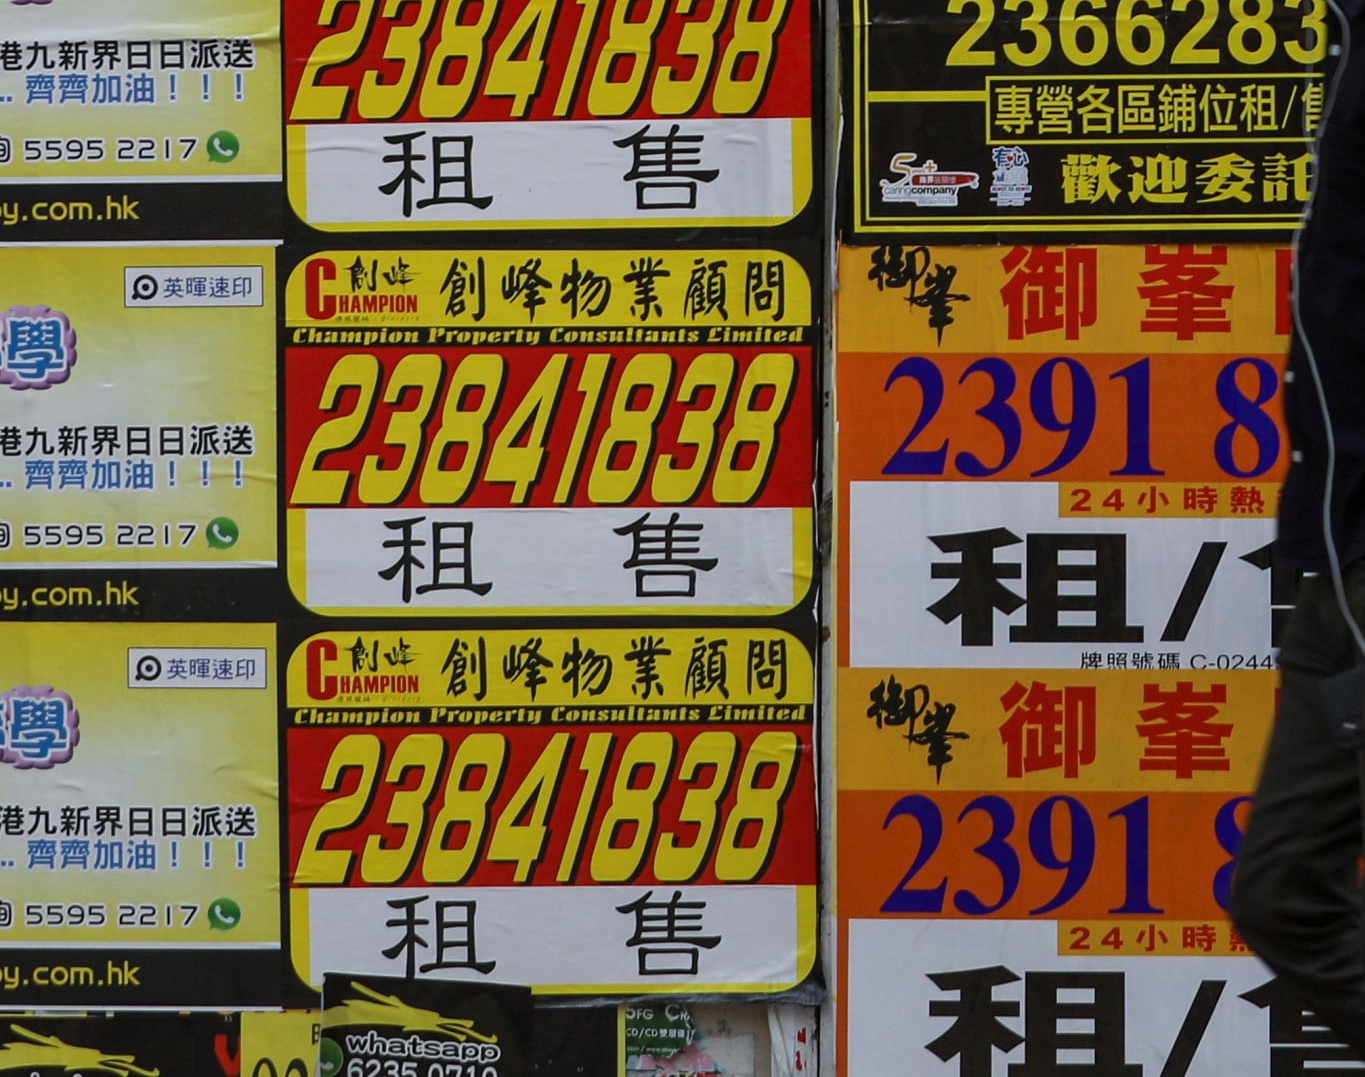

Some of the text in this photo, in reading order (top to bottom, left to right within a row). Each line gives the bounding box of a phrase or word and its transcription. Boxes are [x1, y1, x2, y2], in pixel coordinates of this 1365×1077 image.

[23, 136, 196, 160] 5595 2217
[163, 275, 253, 299] 英暉速印
[440, 258, 786, 321] 創峰物業顧問
[291, 352, 796, 505] 23841838
[880, 356, 1165, 478] 2391
[1071, 487, 1283, 513] 24小時熱
[167, 657, 256, 681] 英暉速印
[441, 637, 788, 701] 創峰物業顧問
[293, 731, 799, 884] 23841838
[880, 795, 1164, 916] 2391
[346, 1032, 501, 1064] whatsapp
